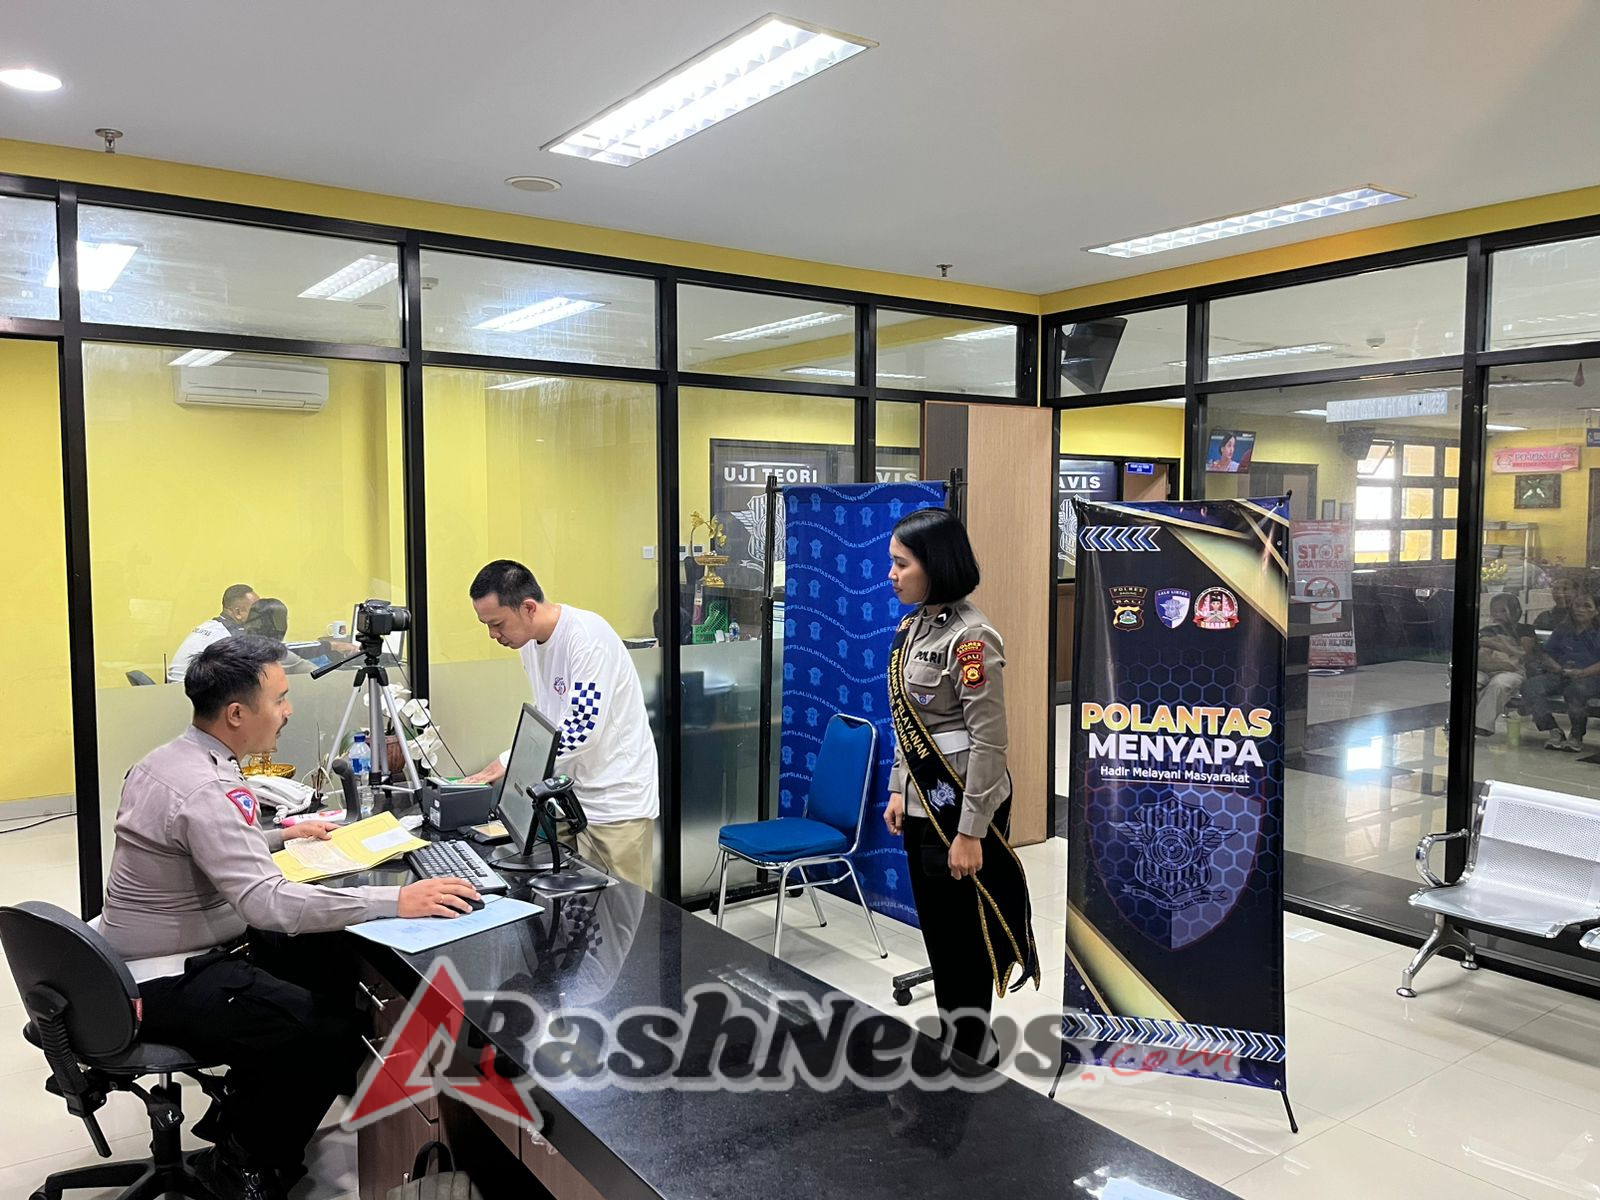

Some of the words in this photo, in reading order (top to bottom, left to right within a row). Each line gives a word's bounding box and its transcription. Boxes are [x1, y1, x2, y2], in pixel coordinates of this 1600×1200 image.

[724, 467, 756, 482] UJI
[762, 468, 818, 483] TEORI
[876, 472, 918, 484] VIS
[1298, 544, 1345, 559] STOP
[1080, 702, 1272, 737] POLANTAS
[896, 698, 930, 760] PELAYANAN
[1088, 733, 1264, 767] MENYAPA
[1101, 766, 1130, 776] Hadir
[1133, 767, 1181, 781] Melayani
[1184, 770, 1251, 784] Masyarakat
